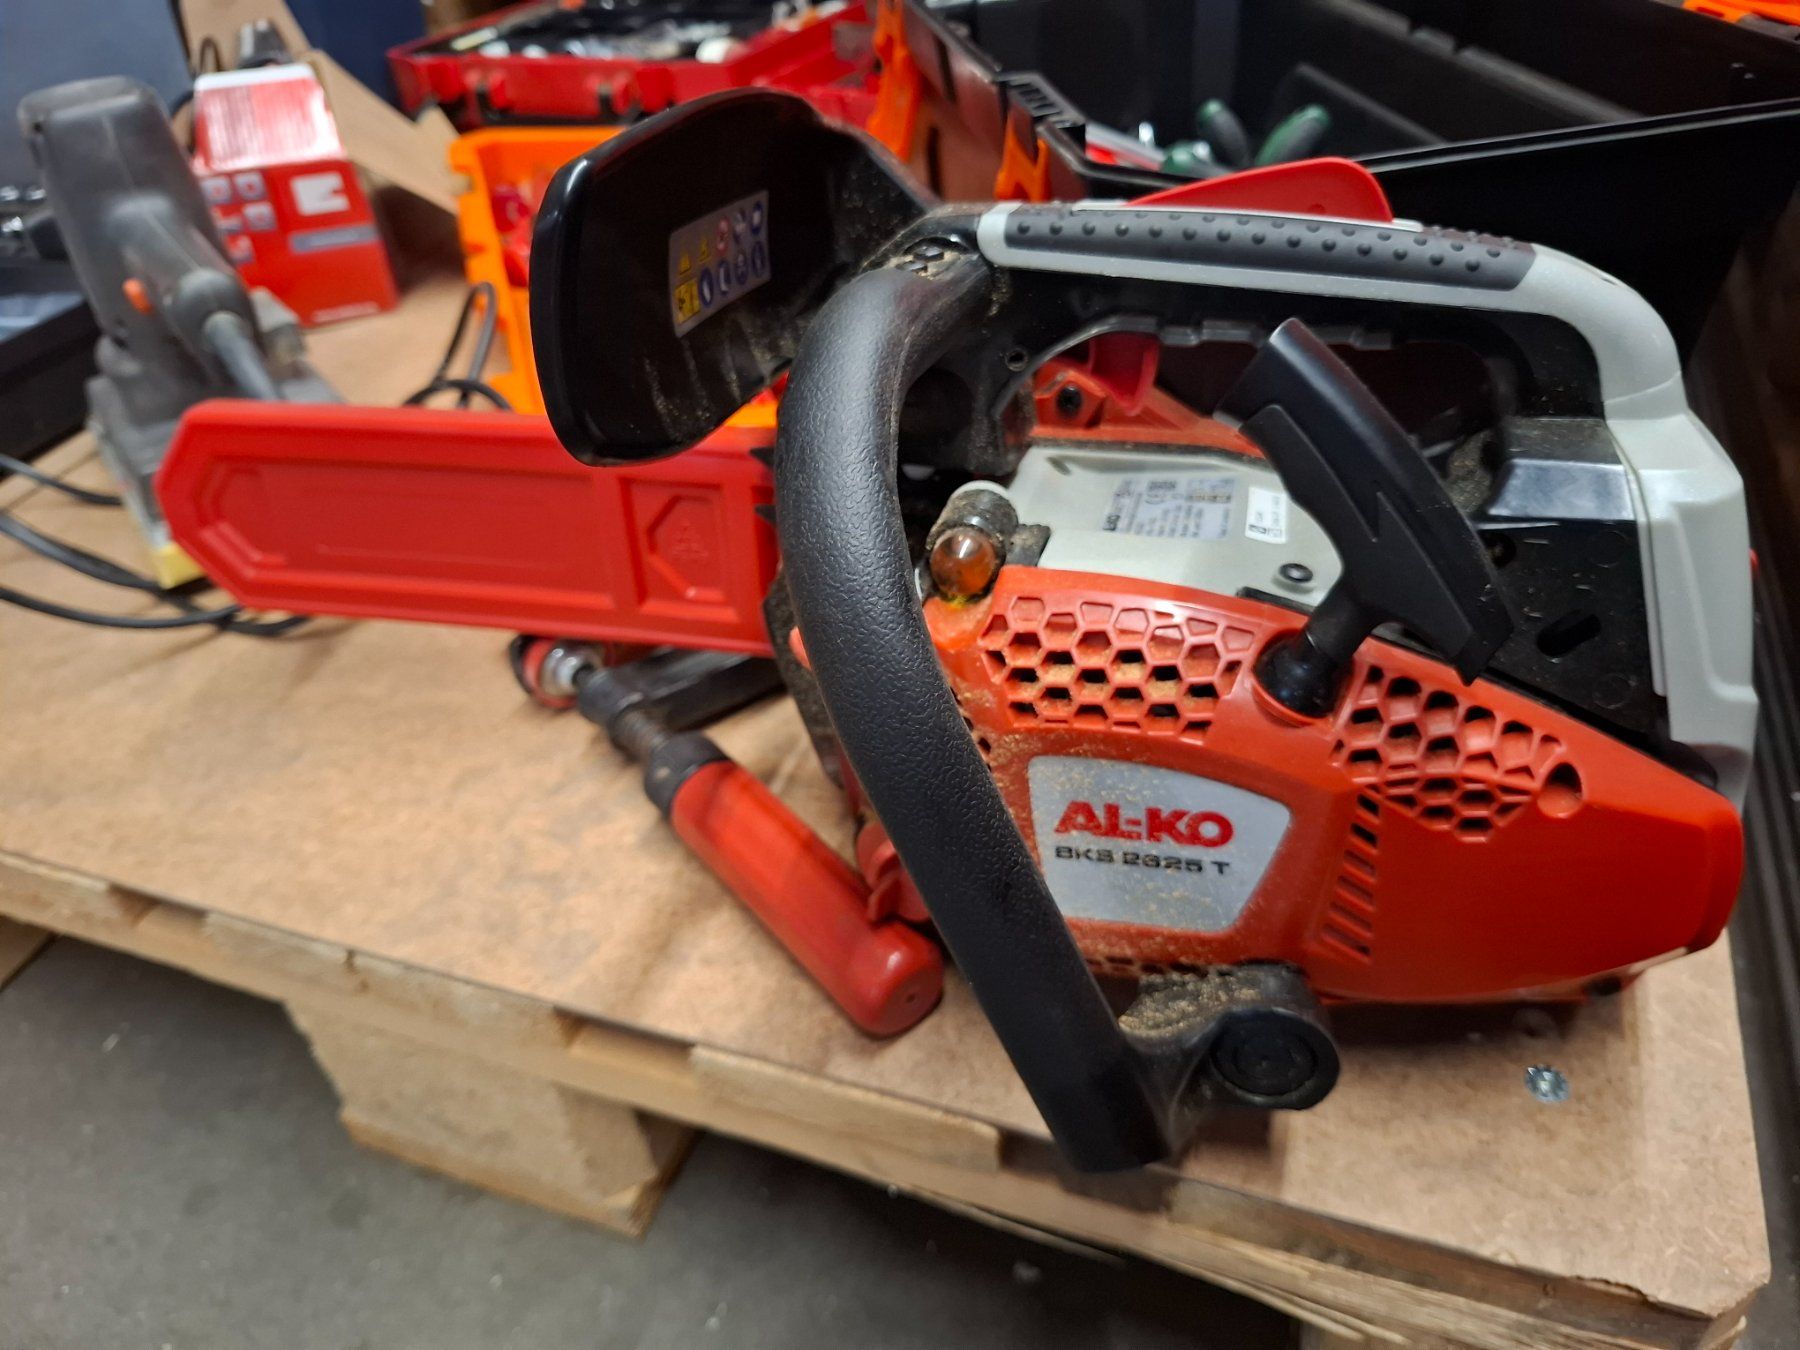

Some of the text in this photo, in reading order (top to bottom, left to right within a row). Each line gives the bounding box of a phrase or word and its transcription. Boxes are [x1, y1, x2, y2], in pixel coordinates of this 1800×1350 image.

[1054, 800, 1234, 848] AL-KO
[1055, 845, 1230, 875] BKS 2625 T
